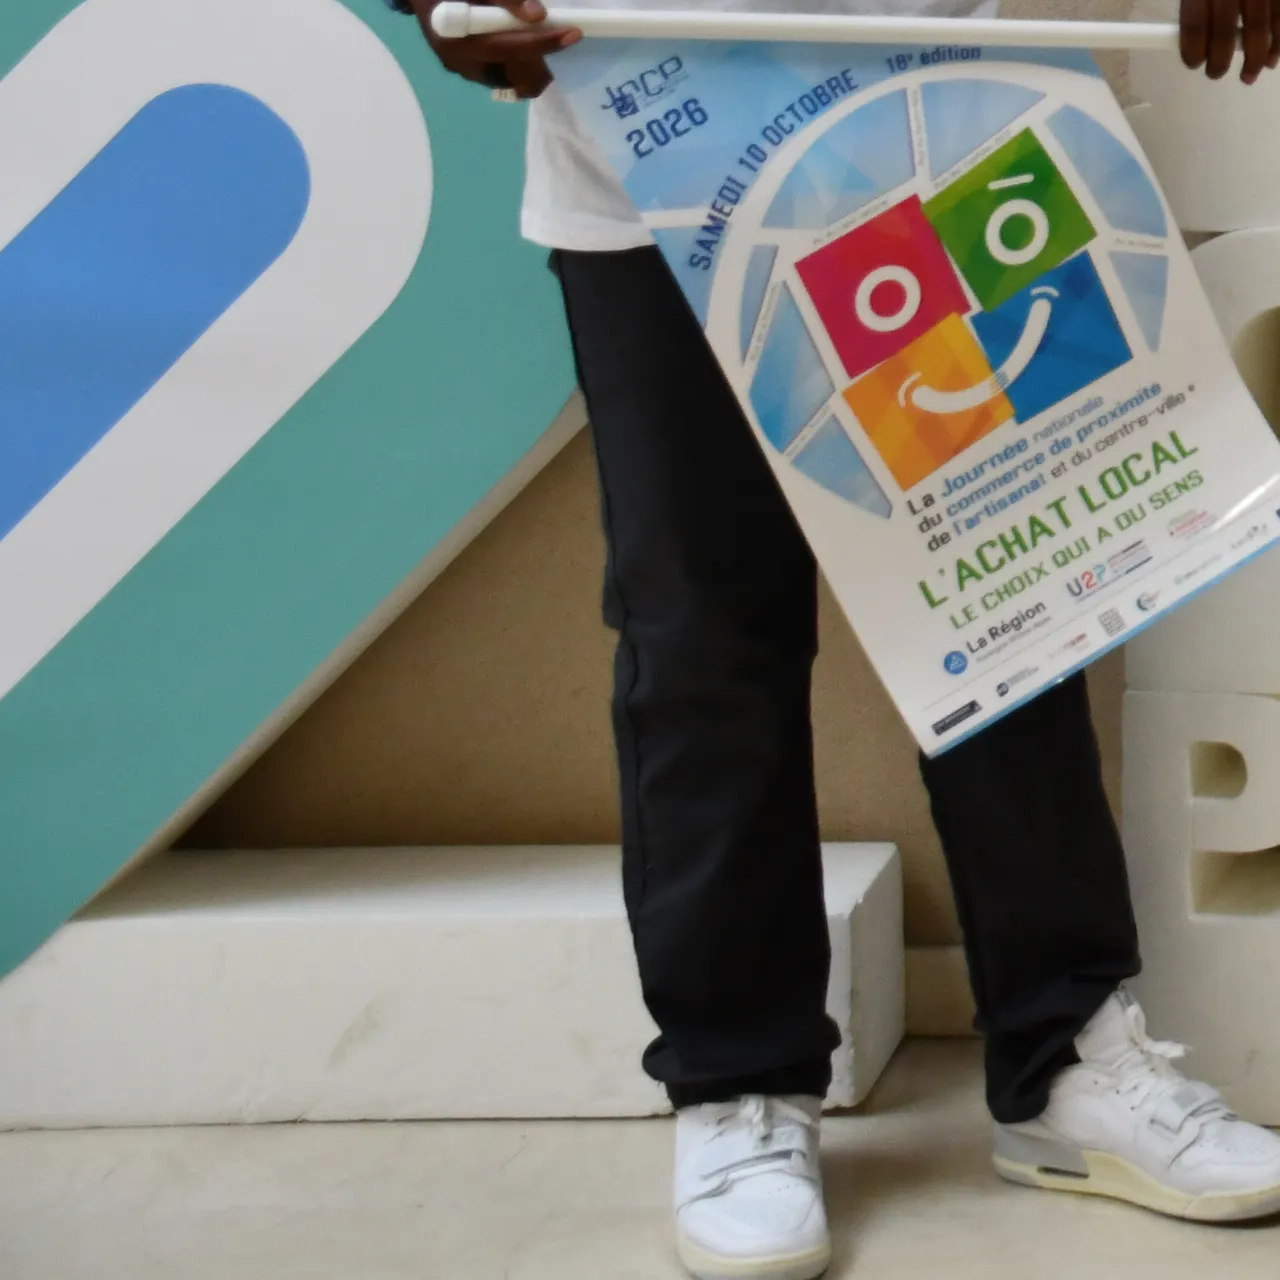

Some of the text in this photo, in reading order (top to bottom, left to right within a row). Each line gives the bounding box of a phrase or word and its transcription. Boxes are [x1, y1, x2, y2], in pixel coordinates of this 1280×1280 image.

[919, 45, 981, 66] édition
[625, 98, 709, 158] 2026
[689, 174, 748, 271] SAMEDI
[738, 143, 768, 173] 10
[761, 68, 860, 148] OCTOBRE
[906, 491, 936, 516] La
[917, 513, 944, 534] du
[946, 452, 1047, 518] commerce
[1049, 434, 1073, 456] de
[917, 430, 1199, 609] L'ACHAT LOCAL
[926, 530, 952, 553] de
[1050, 461, 1068, 478] et
[1071, 447, 1093, 468] du
[949, 603, 979, 630] LE
[980, 562, 1052, 612] CHOIX
[1051, 535, 1092, 570] QUI
[1096, 525, 1113, 545] A
[1114, 502, 1147, 532] DU
[1149, 468, 1205, 511] SENS
[965, 635, 989, 654] La
[987, 601, 1047, 641] Région
